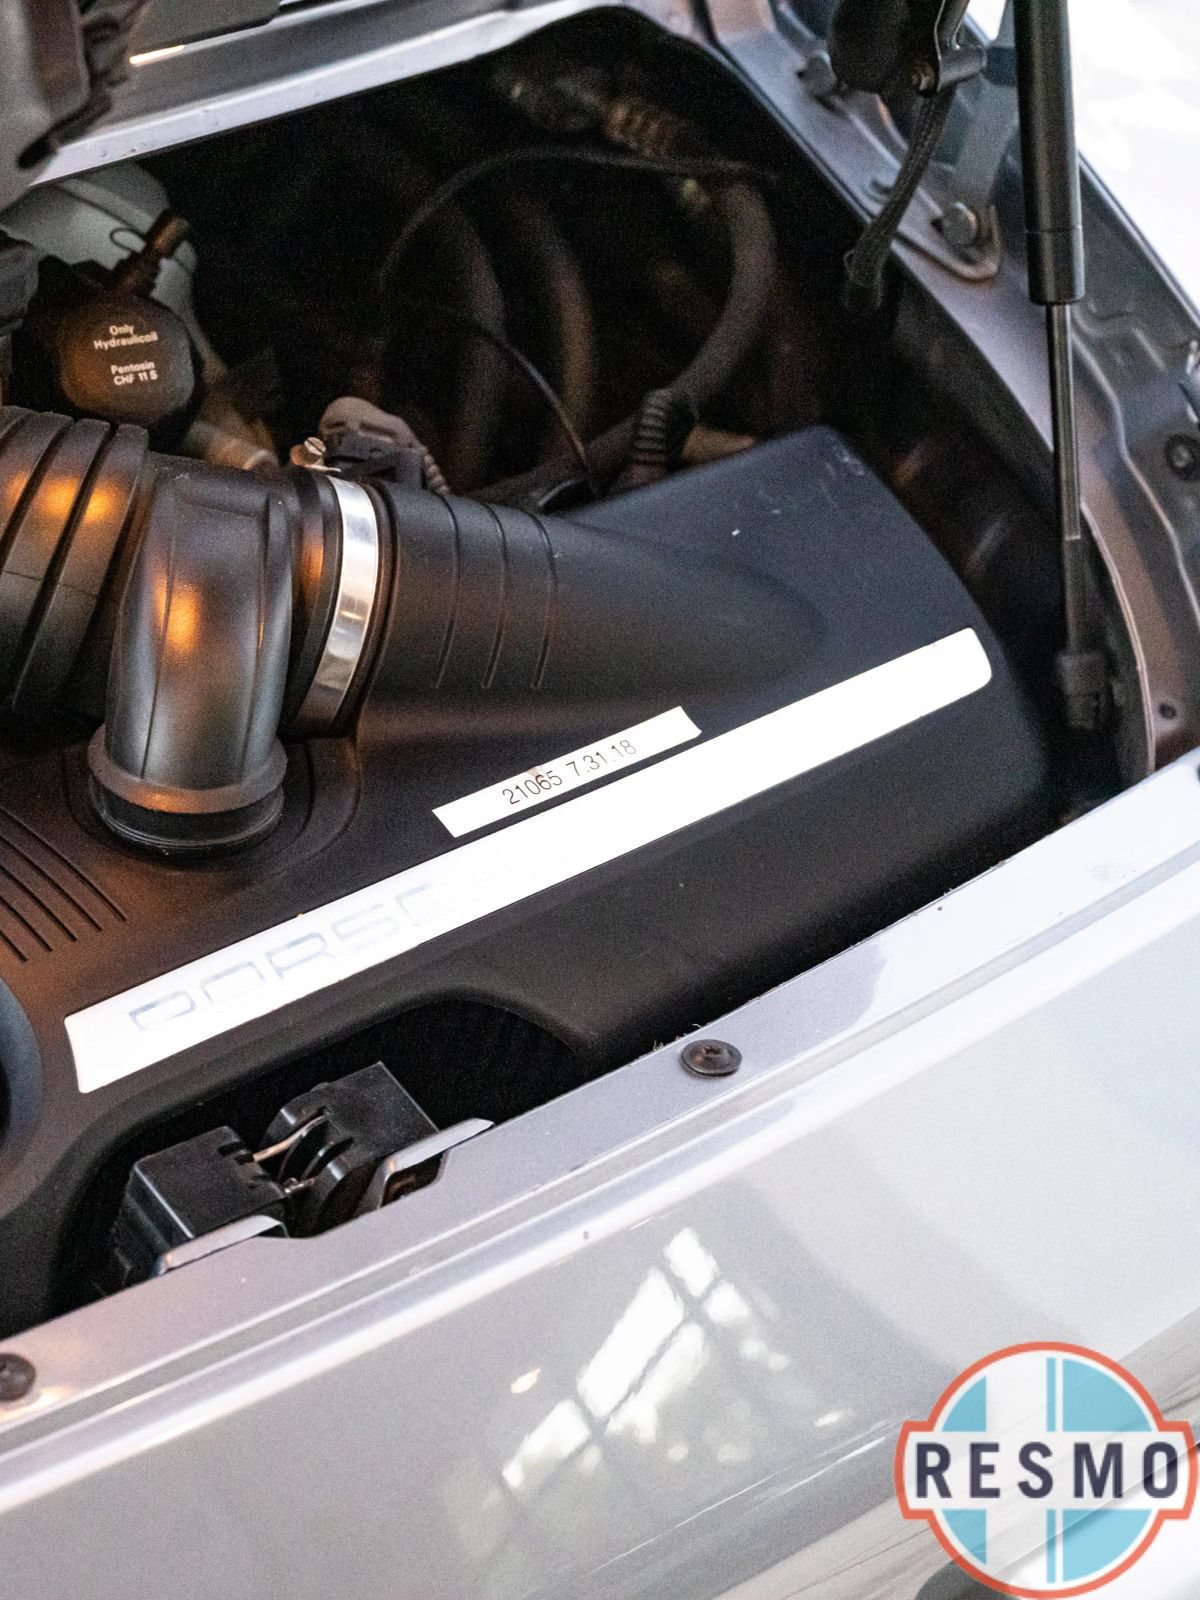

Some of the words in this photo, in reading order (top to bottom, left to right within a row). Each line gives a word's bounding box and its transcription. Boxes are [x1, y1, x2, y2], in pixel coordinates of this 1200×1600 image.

[109, 324, 134, 336] Only
[93, 331, 158, 350] Hydraulicoil
[110, 360, 155, 374] Pentosin
[113, 373, 134, 385] CHF
[138, 371, 148, 381] 11
[149, 370, 158, 380] S
[502, 770, 563, 805] 21065
[565, 739, 637, 777] 7.31.18
[128, 865, 512, 1032] PORSC
